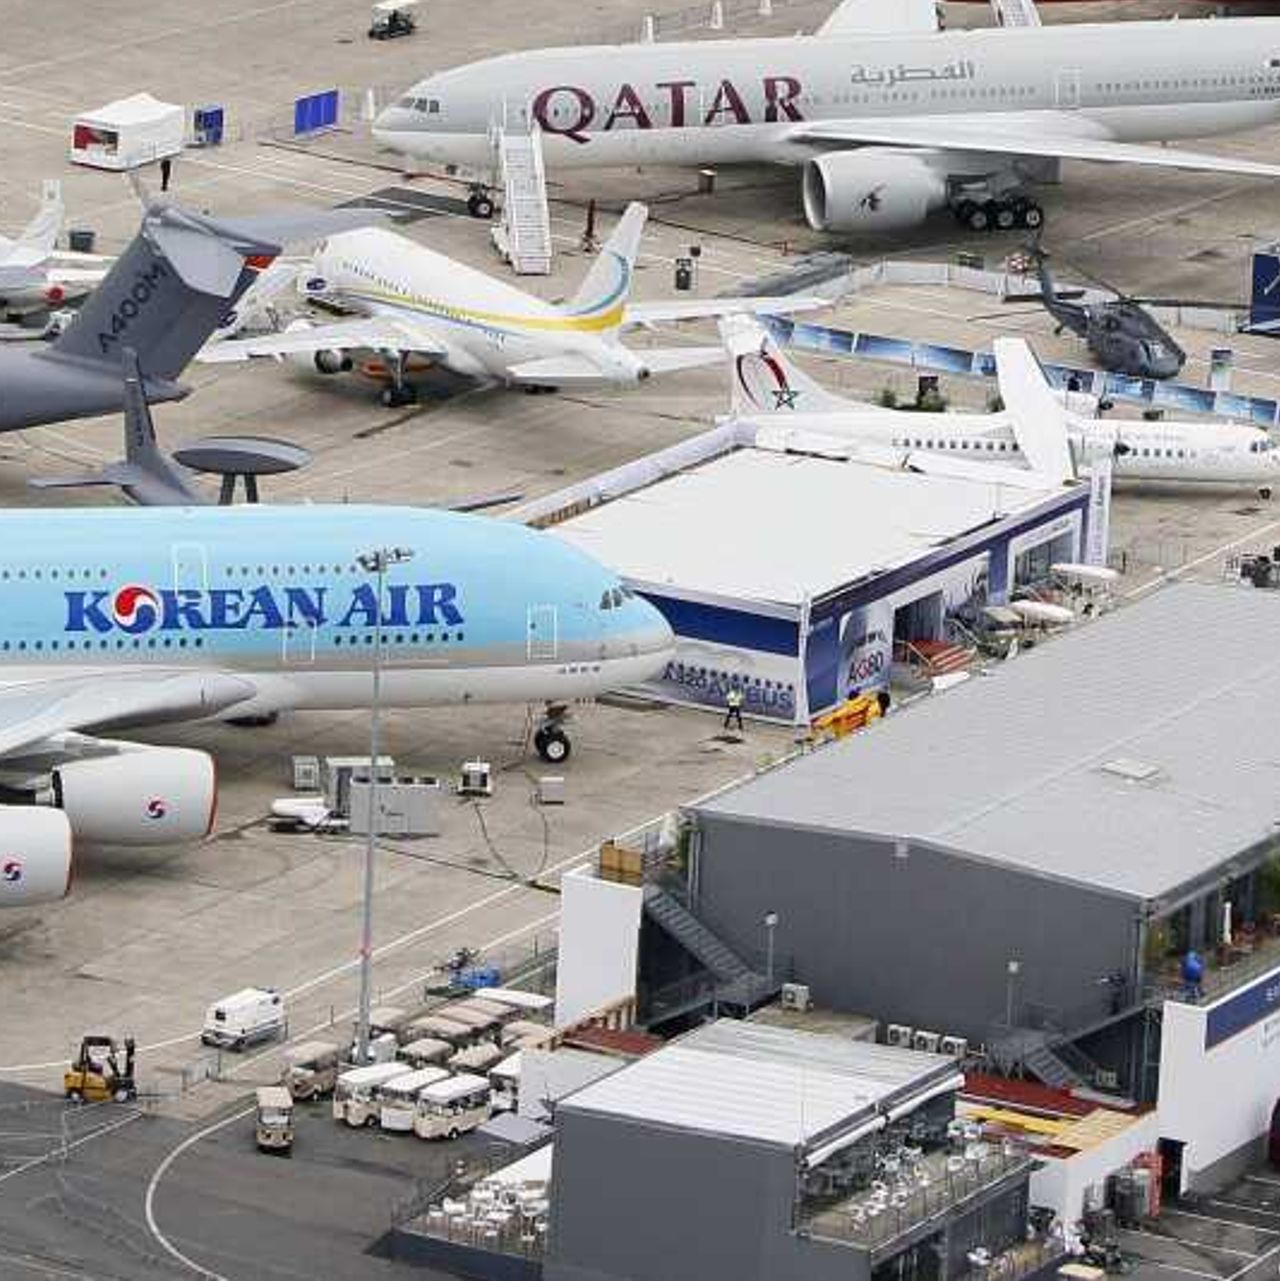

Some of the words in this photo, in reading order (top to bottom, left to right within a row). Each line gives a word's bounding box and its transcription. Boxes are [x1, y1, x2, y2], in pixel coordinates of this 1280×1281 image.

[533, 75, 806, 143] QATAR
[97, 262, 168, 353] A400M
[65, 586, 326, 633] KOREAN
[340, 582, 464, 628] AIR
